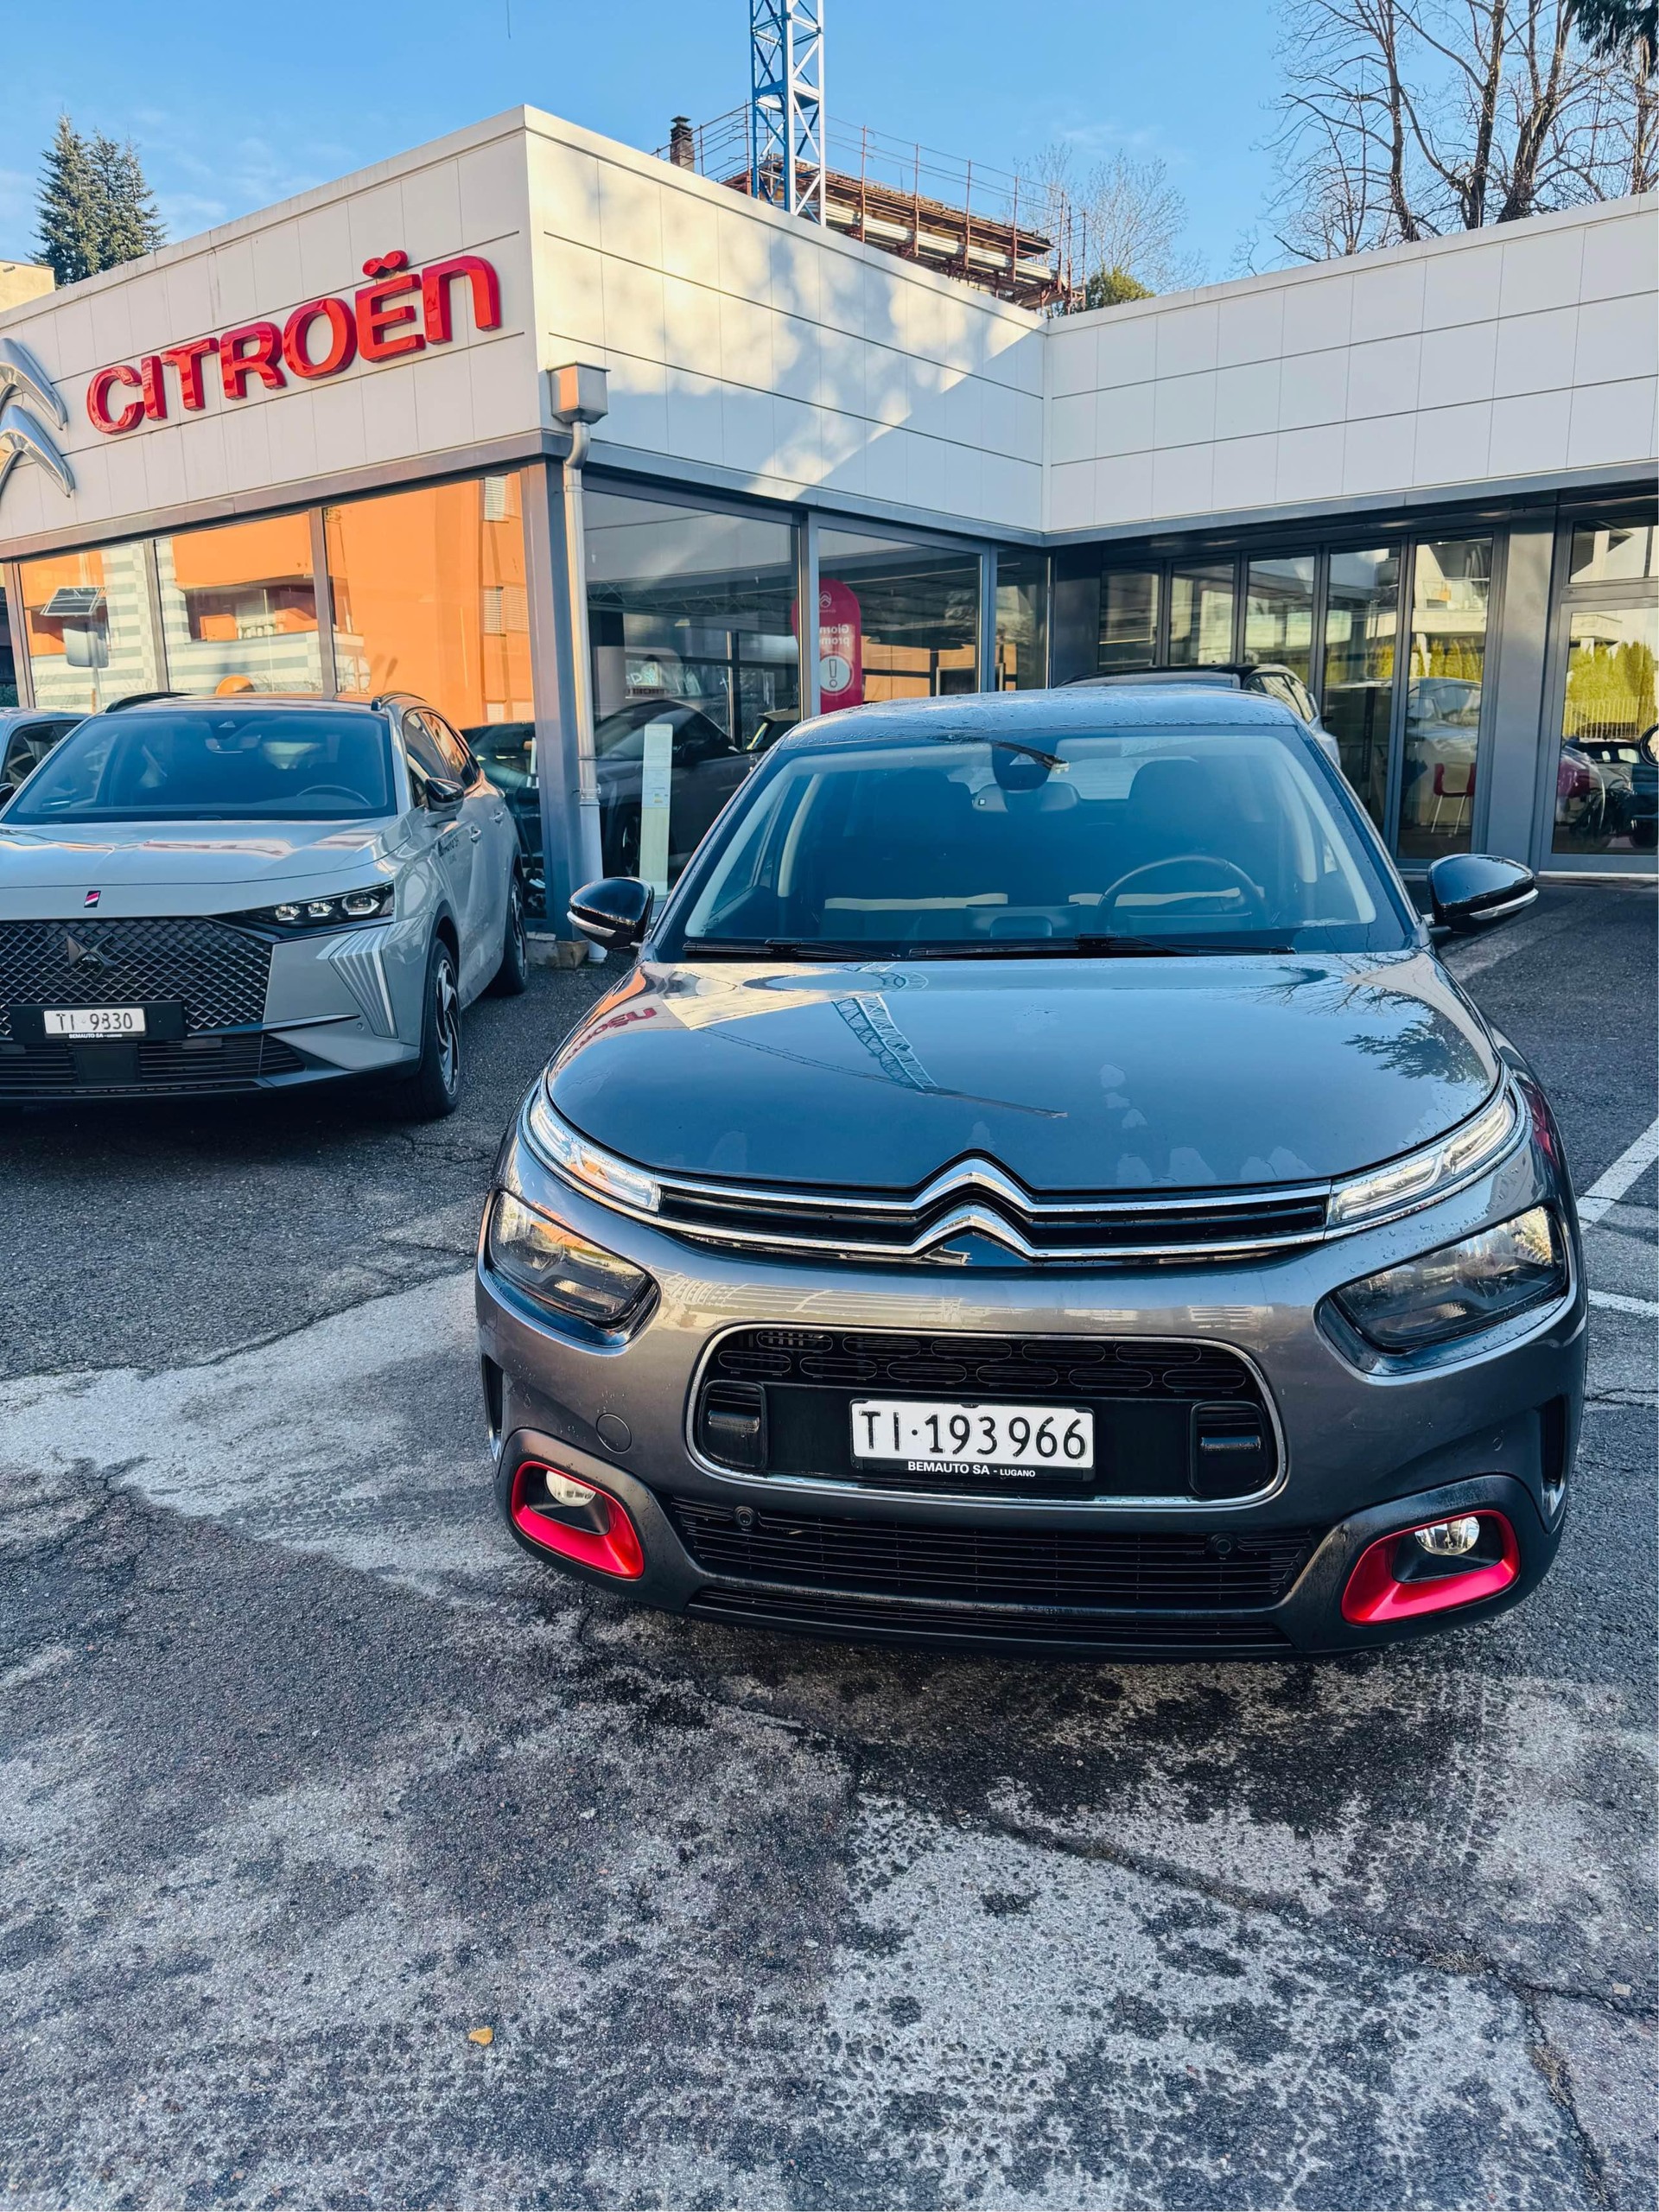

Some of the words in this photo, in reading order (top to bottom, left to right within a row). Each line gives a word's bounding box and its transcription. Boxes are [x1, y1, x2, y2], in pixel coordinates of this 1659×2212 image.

[907, 1460, 969, 1474] BEMAUTO
[972, 1464, 990, 1475] SA
[1000, 1468, 1036, 1478] LUGANO
